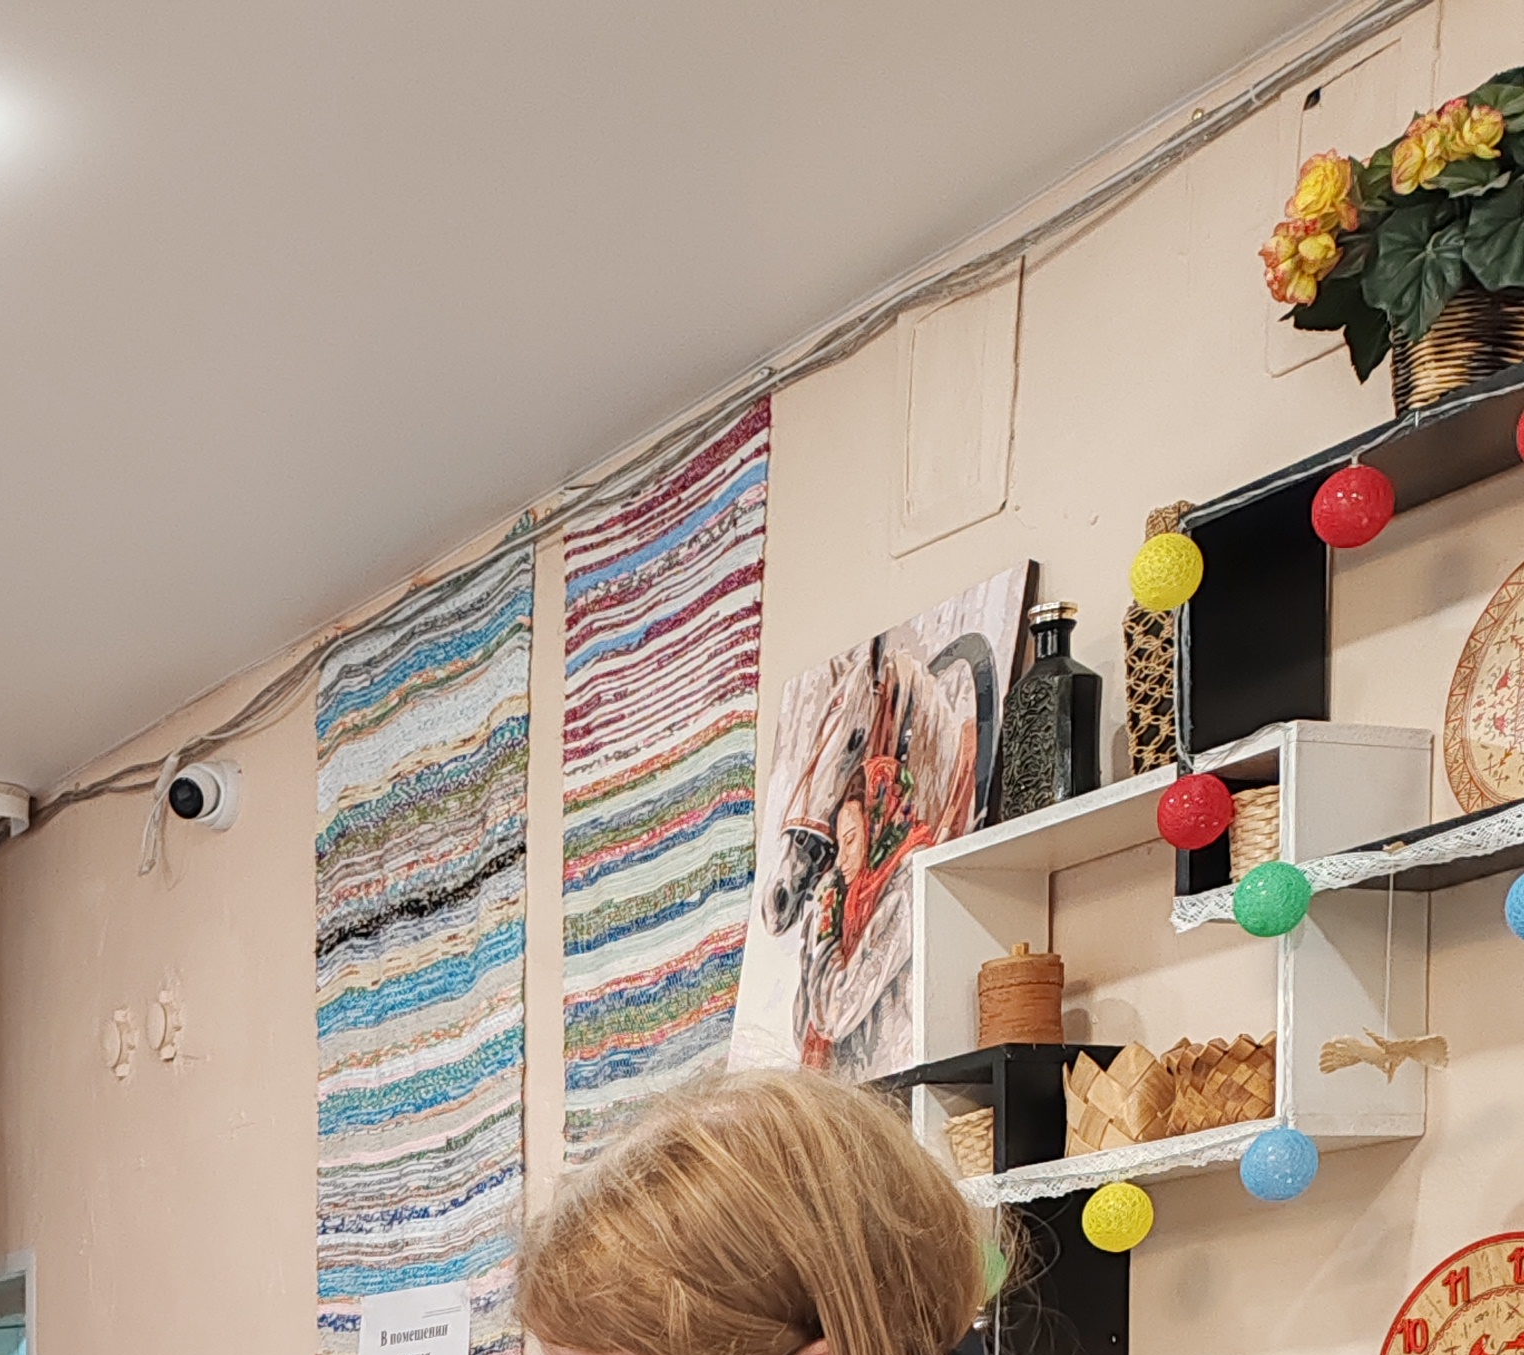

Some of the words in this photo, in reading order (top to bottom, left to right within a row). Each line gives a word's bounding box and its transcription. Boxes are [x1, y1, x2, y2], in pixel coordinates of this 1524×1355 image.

[1441, 1265, 1471, 1307] 11
[379, 1330, 388, 1348] В
[390, 1324, 449, 1345] помещении
[1395, 1317, 1429, 1355] 10
